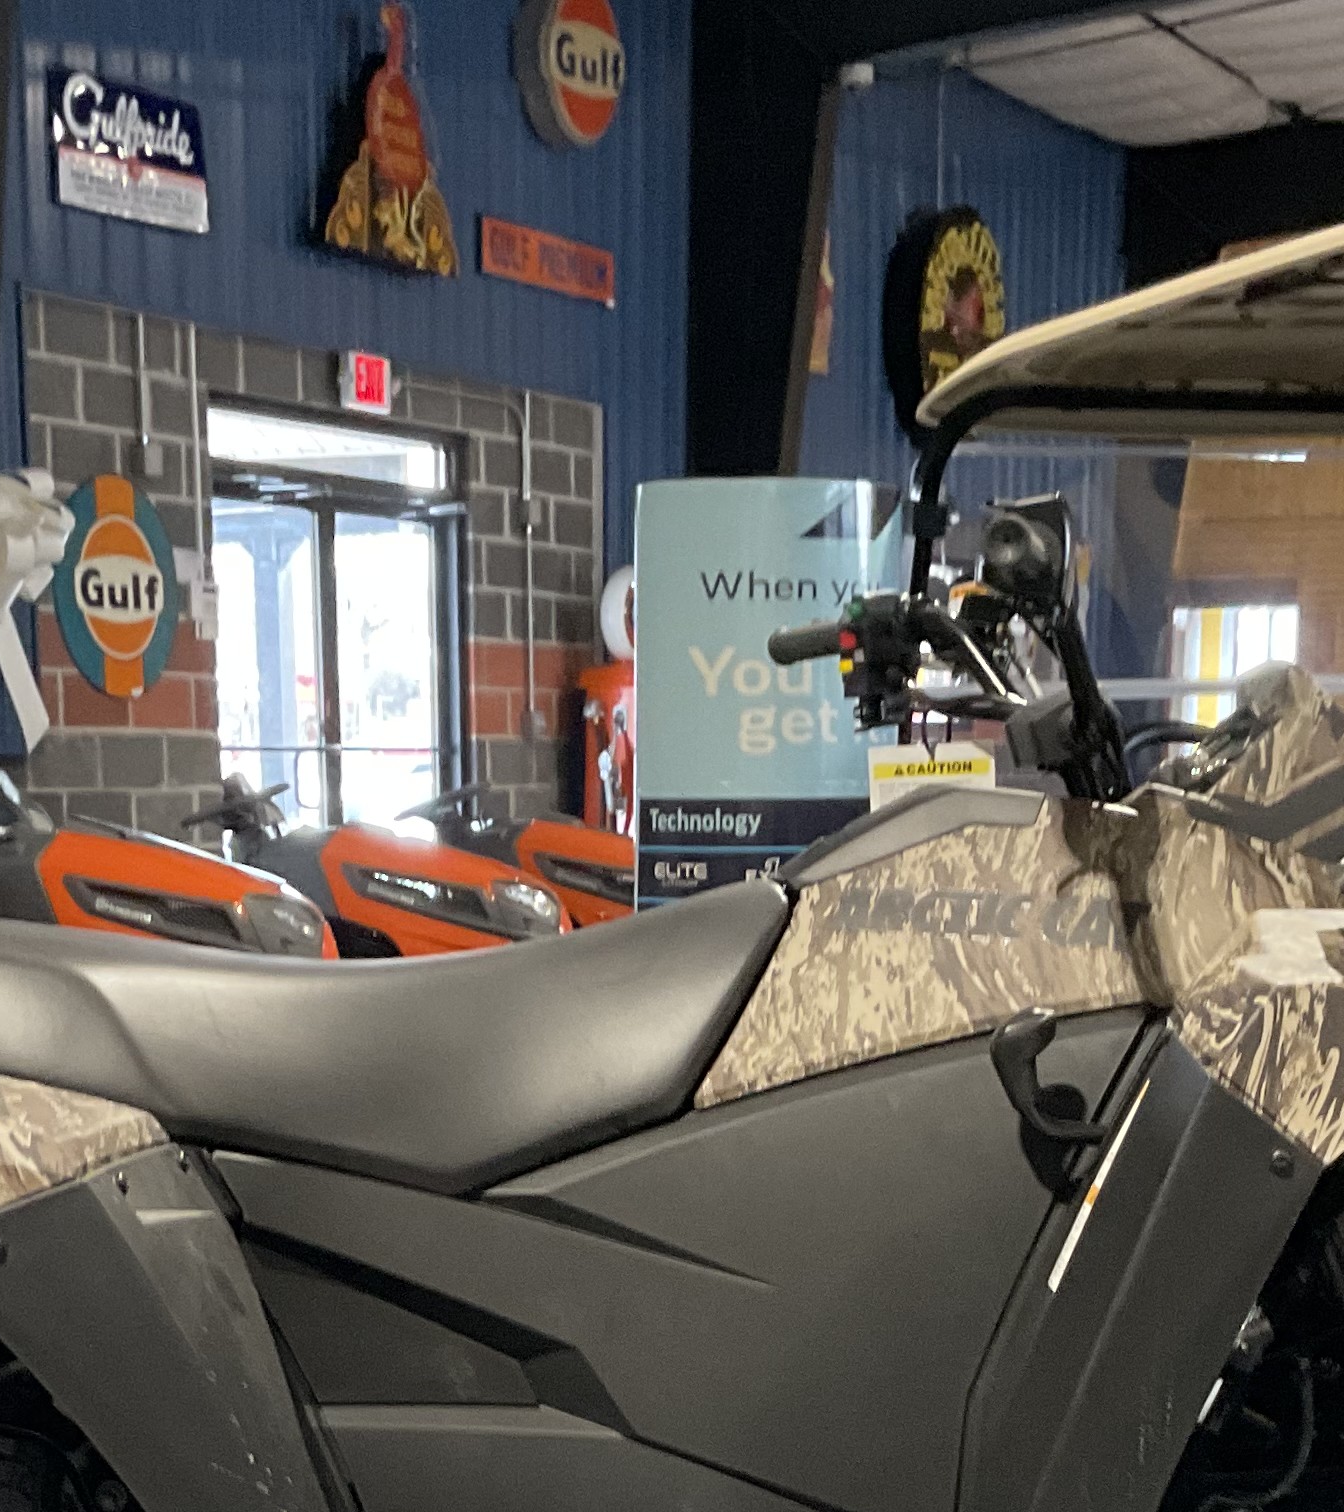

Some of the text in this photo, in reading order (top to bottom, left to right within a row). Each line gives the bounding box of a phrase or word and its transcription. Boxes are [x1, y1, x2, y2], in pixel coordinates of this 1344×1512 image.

[557, 33, 621, 90] Gulf
[63, 73, 194, 166] Gulfpride
[356, 355, 384, 404] EXIT
[80, 567, 159, 611] Gulf
[701, 570, 817, 601] When
[688, 646, 813, 697] You
[737, 702, 839, 755] get
[906, 761, 973, 775] CAUTION
[649, 808, 761, 836] Technology
